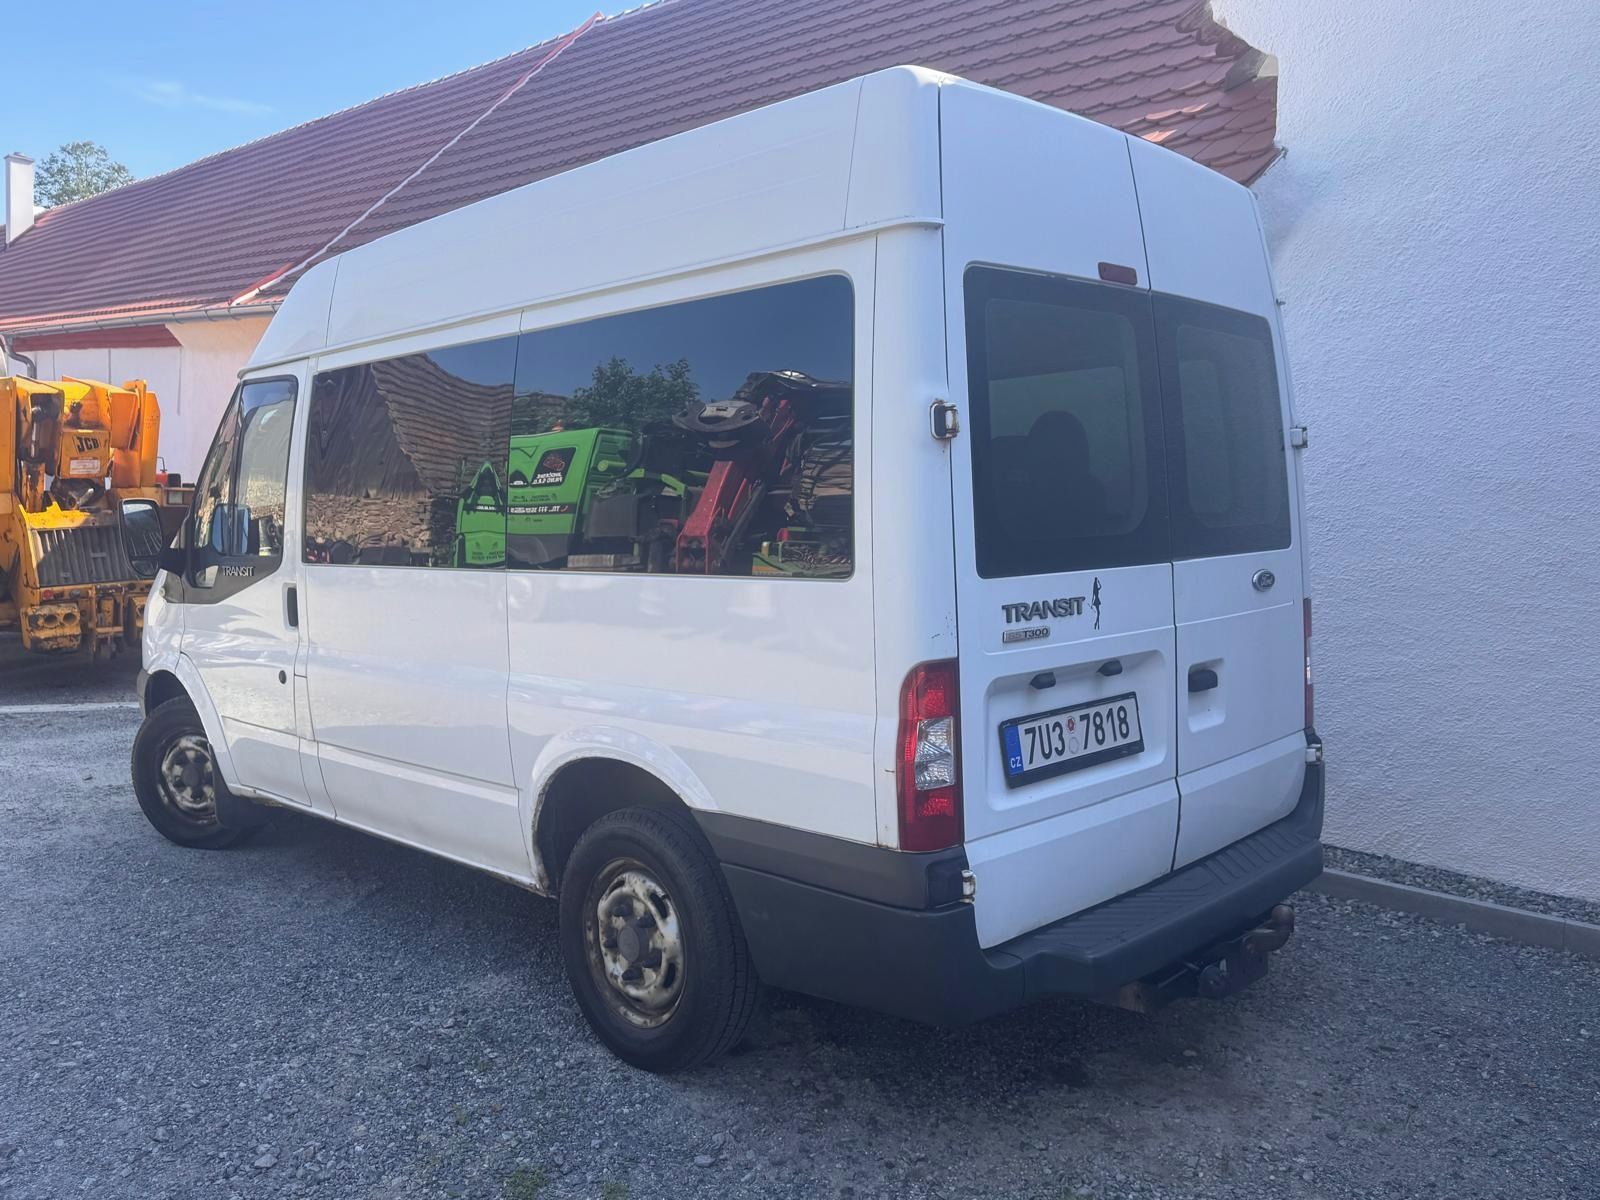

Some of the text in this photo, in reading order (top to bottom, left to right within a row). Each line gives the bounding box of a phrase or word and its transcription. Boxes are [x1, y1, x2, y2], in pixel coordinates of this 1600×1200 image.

[75, 435, 99, 452] JCB
[222, 565, 256, 577] TRANSIT
[1002, 596, 1086, 624] TRANSIT
[1024, 627, 1049, 638] T300
[1024, 705, 1130, 765] 7U3 7818
[1010, 756, 1022, 769] CZ
